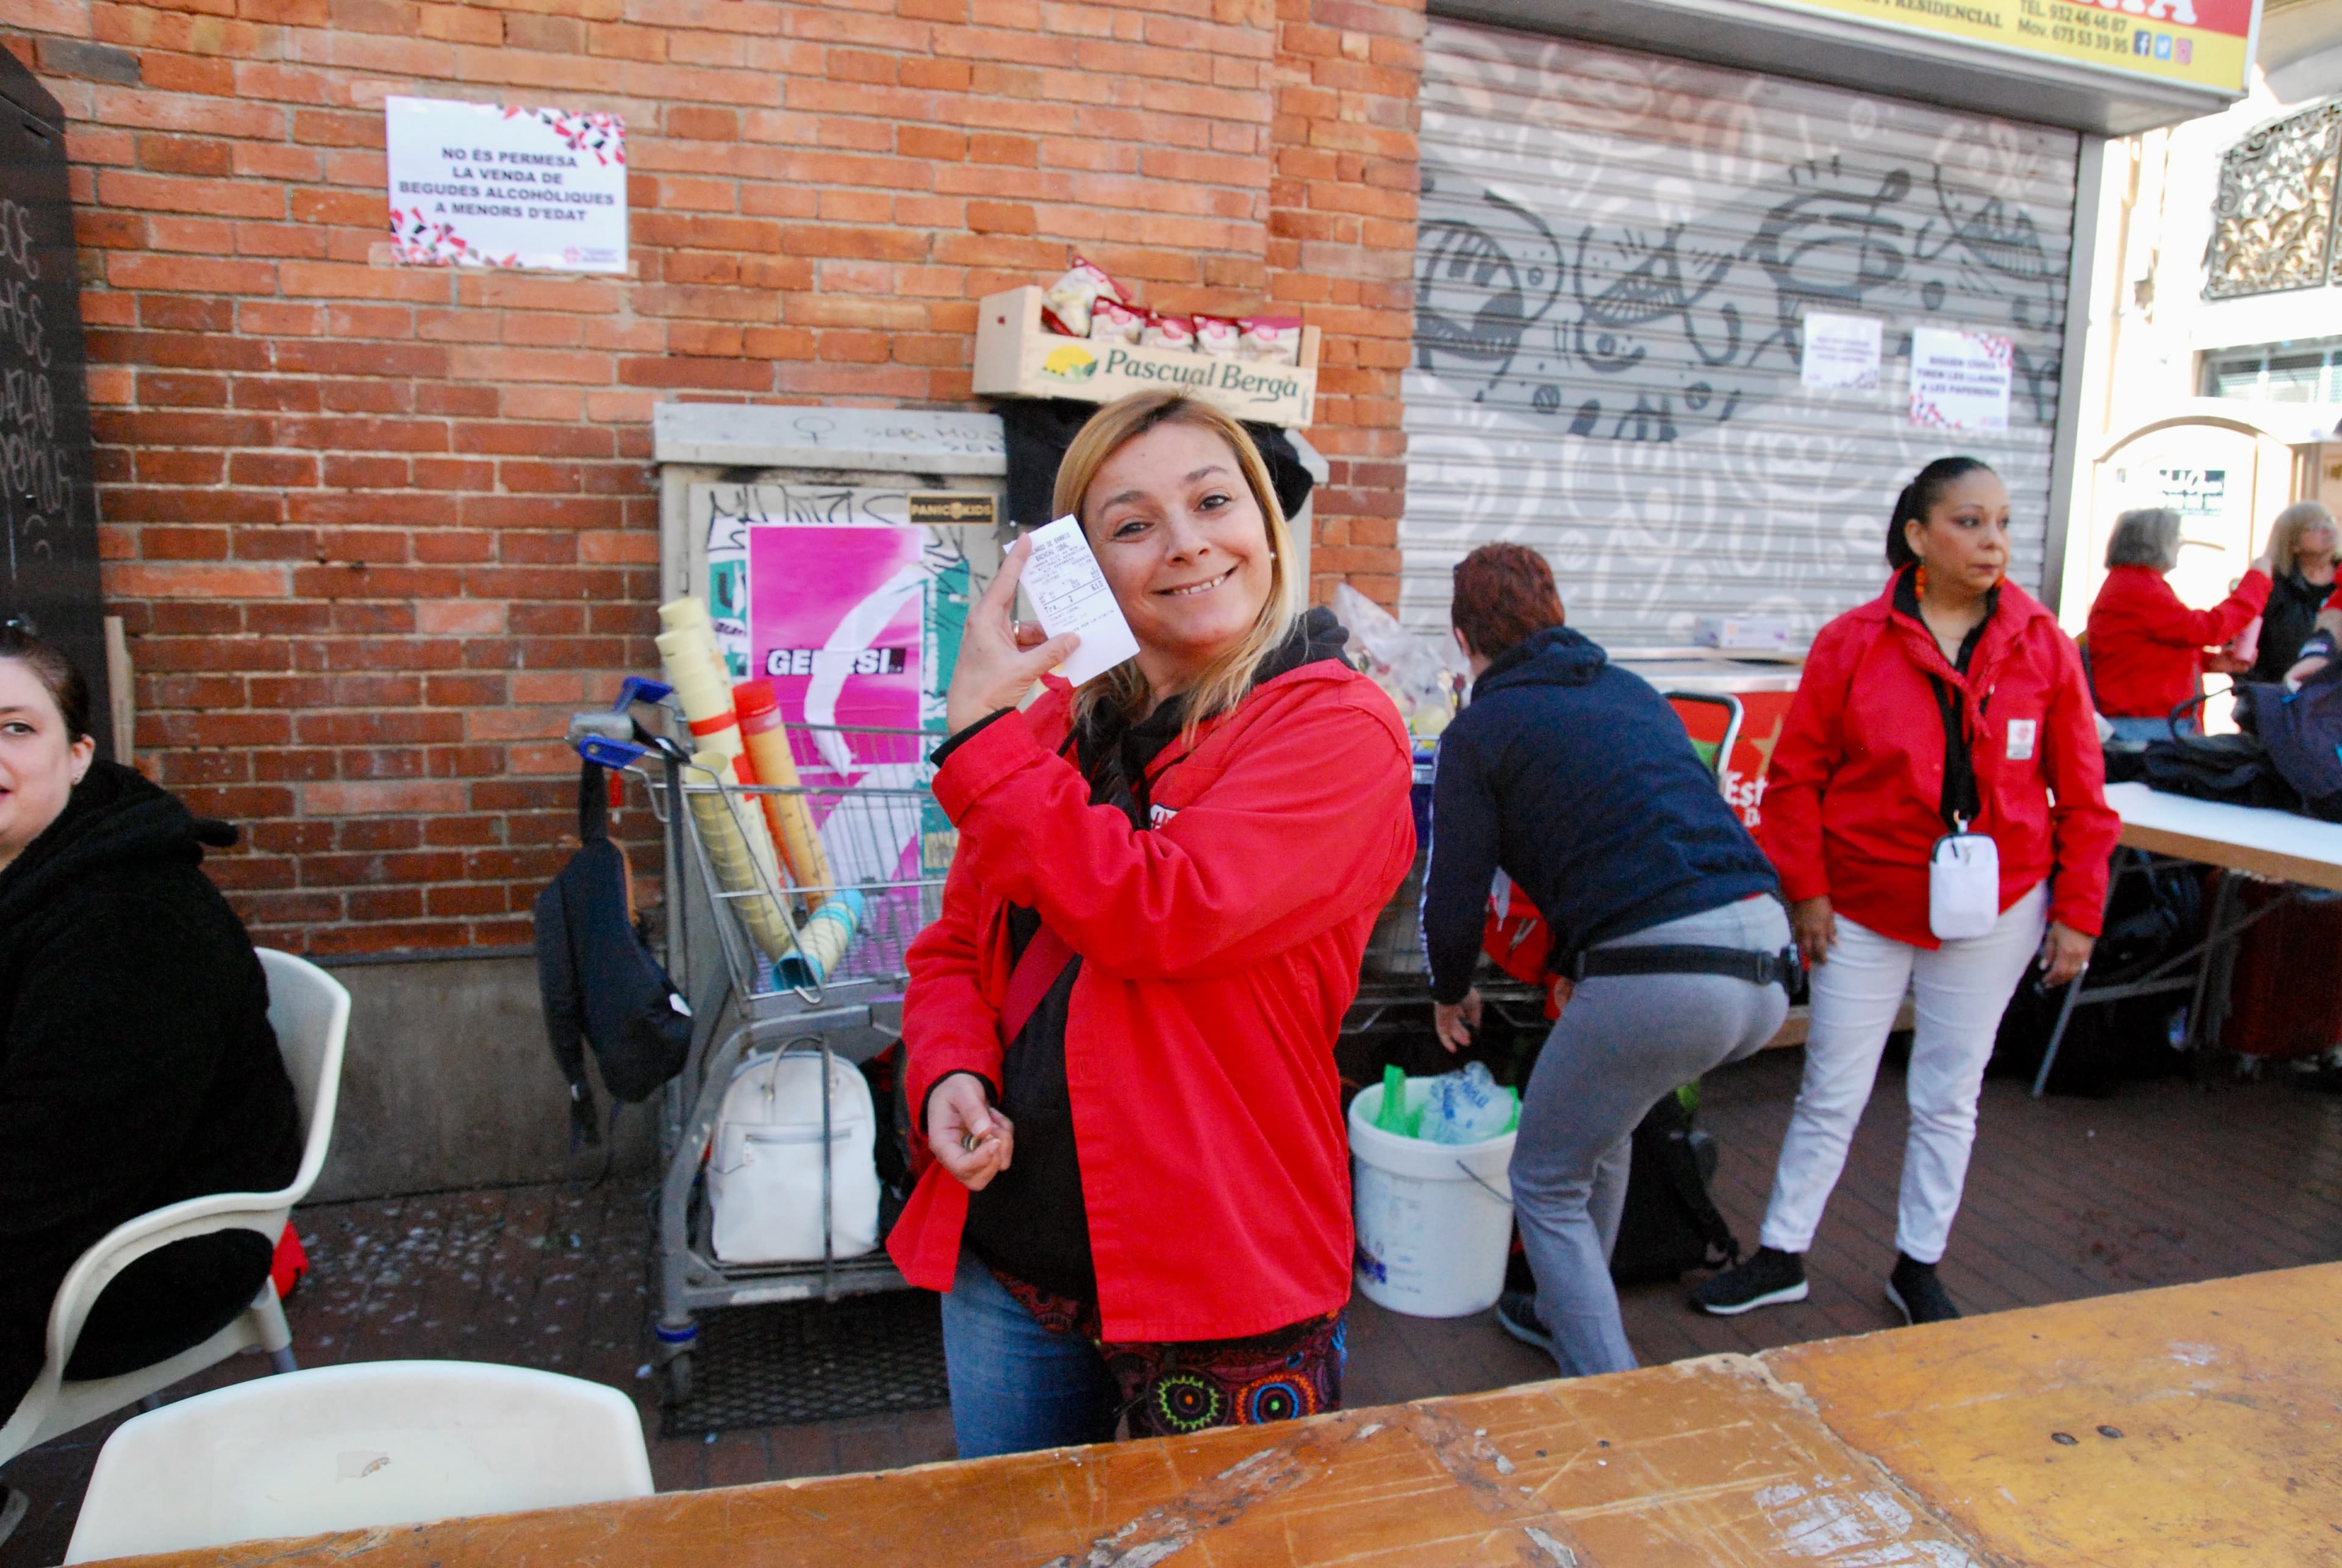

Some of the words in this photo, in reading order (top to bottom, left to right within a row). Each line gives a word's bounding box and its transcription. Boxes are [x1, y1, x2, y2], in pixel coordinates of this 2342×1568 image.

[442, 147, 467, 160] NO
[499, 151, 578, 168] PERMESA
[453, 166, 473, 179] LA
[479, 168, 535, 183] VENDA
[542, 172, 562, 184] DE
[399, 181, 479, 197] BEGUDES
[487, 186, 614, 206] ALCOHÒLIQUES
[434, 202, 445, 213] A
[451, 202, 521, 218] MENORS
[528, 207, 586, 221] D'EDAT
[1105, 349, 1216, 387] Pascual
[910, 504, 951, 516] PANIC
